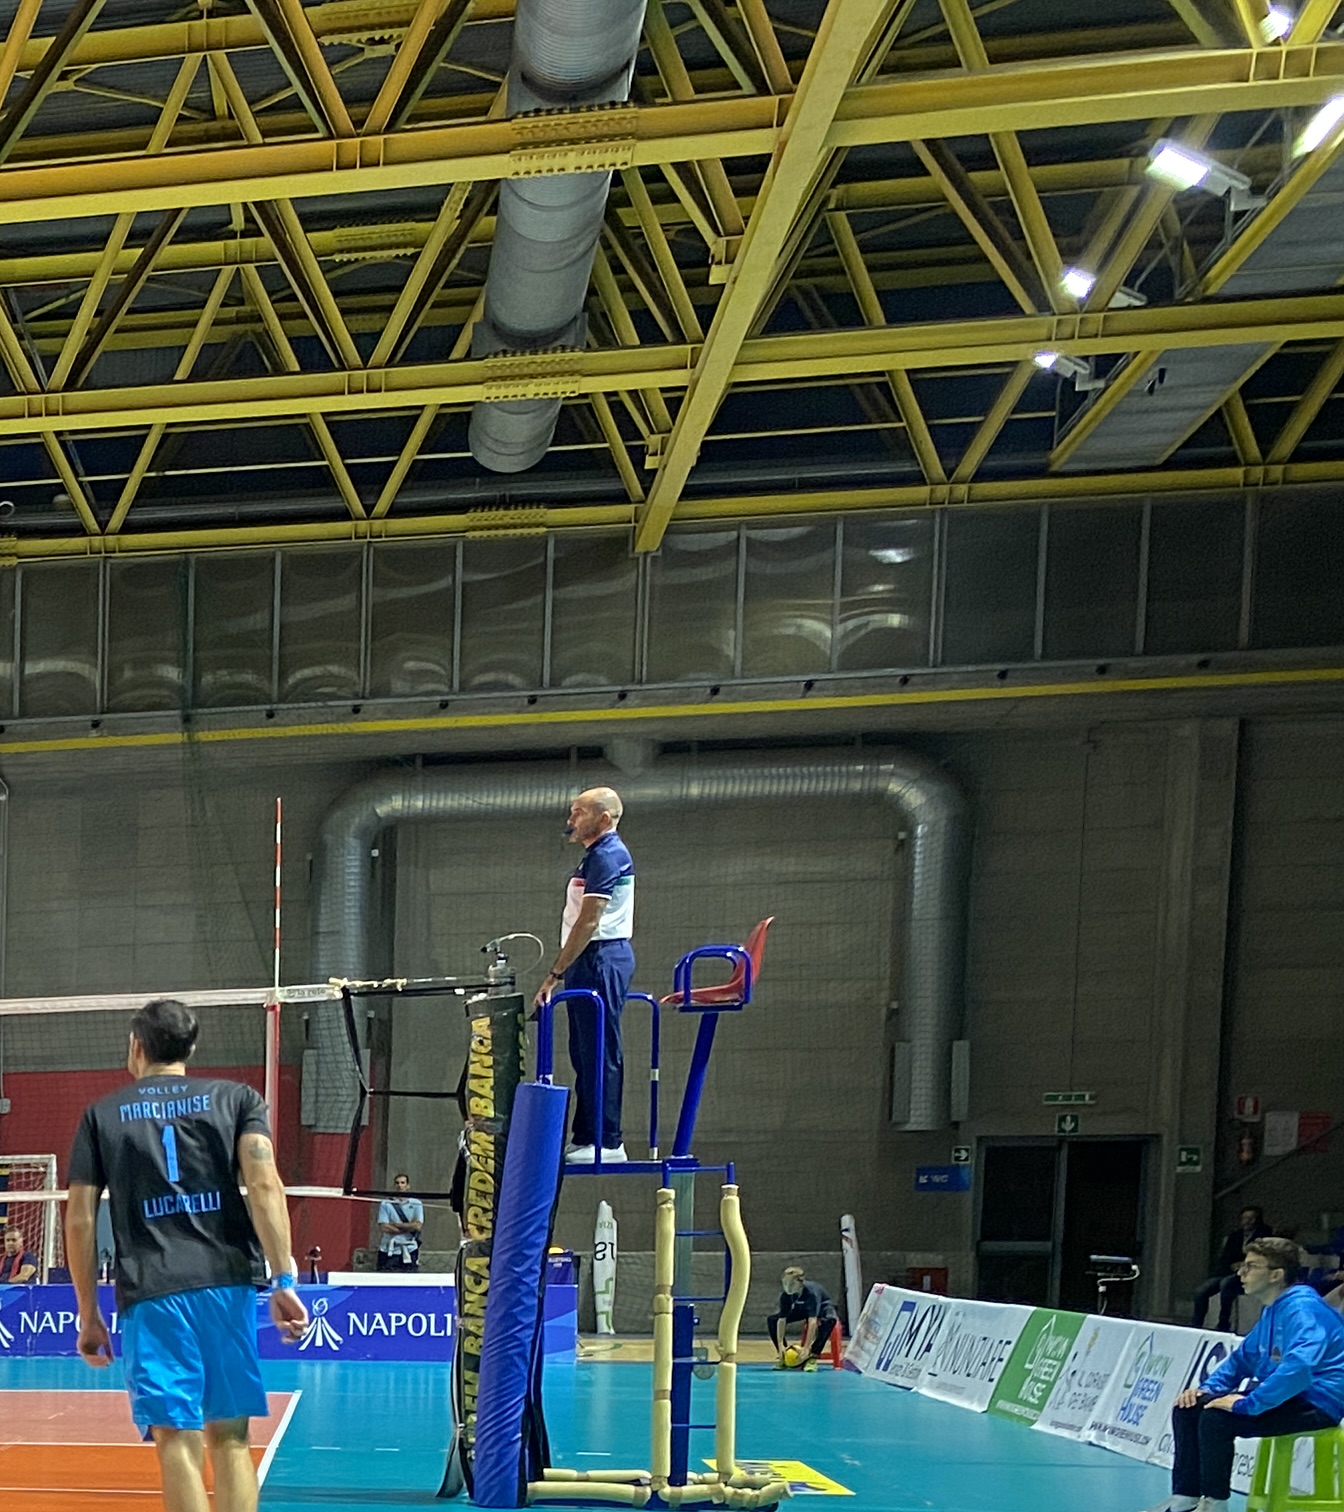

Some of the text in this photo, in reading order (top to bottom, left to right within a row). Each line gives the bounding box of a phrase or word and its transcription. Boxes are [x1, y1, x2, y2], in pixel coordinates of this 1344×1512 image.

[138, 1085, 189, 1095] VOLLEY
[119, 1094, 211, 1123] MARCIANISE
[467, 1016, 496, 1241] CREDEM BANCA
[161, 1125, 180, 1182] 1
[143, 1191, 221, 1219] LUCARELLI
[18, 1311, 118, 1334] NAPI
[347, 1312, 452, 1337] NAPOLI
